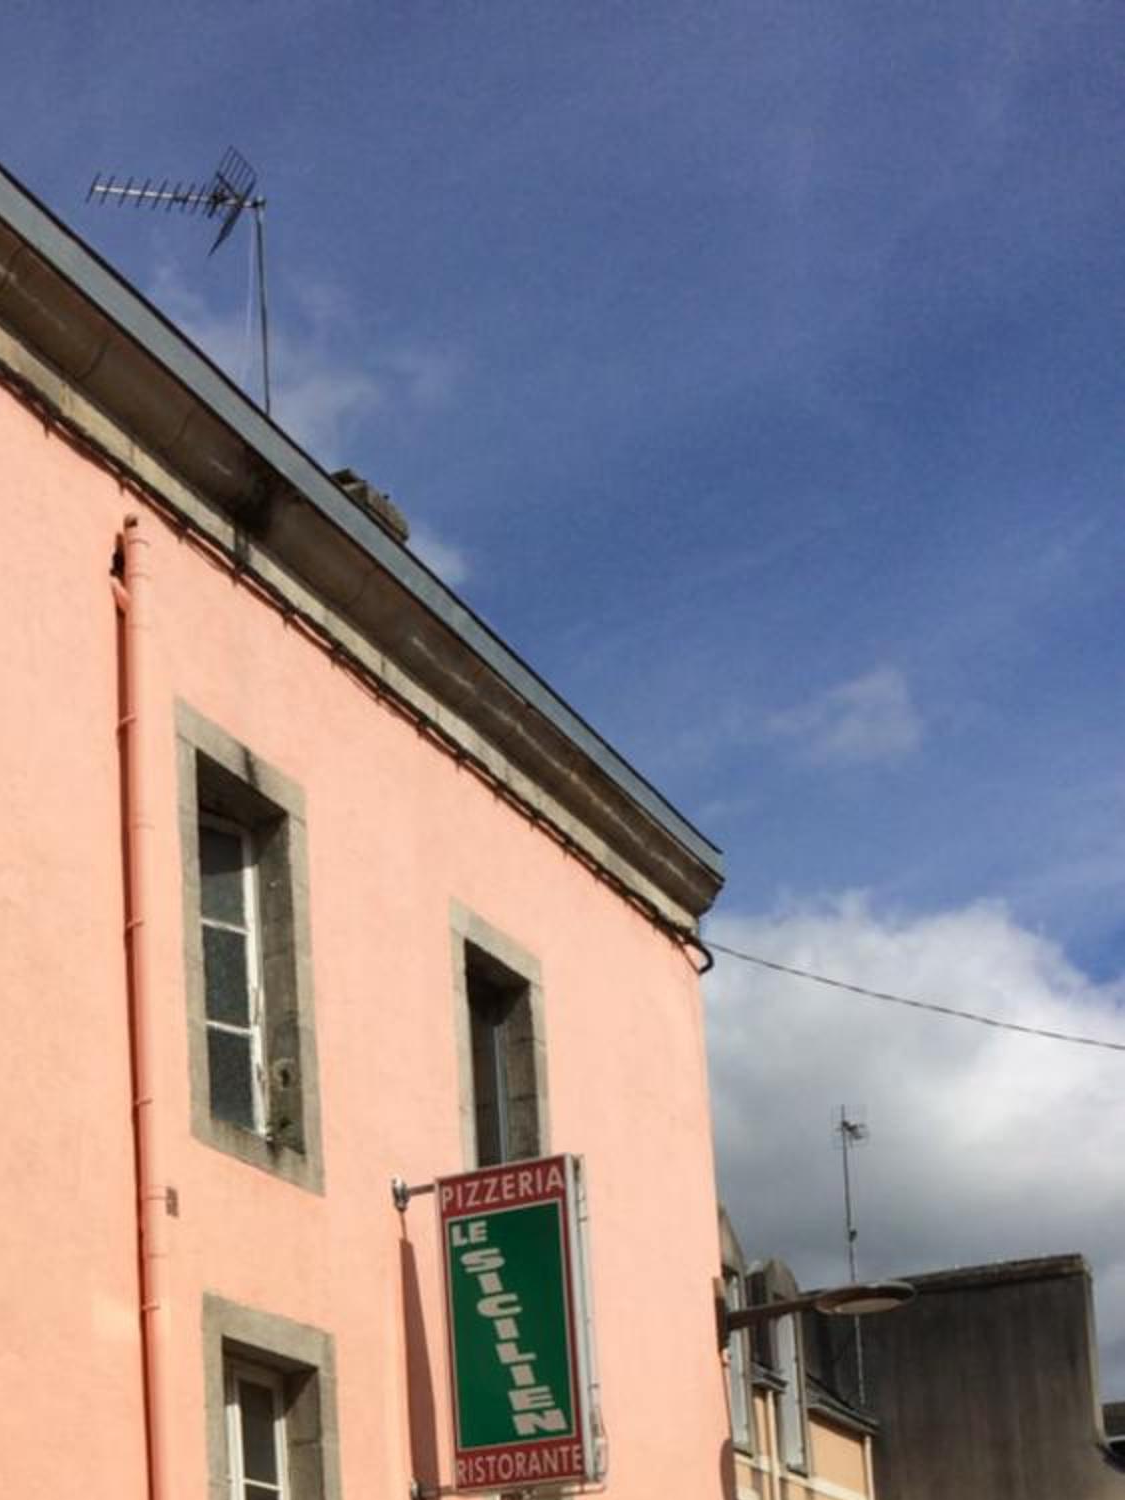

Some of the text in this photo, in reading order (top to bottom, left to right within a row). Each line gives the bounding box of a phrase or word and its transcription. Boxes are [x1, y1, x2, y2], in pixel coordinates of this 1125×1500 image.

[441, 1164, 564, 1213] PIZZERIA
[451, 1221, 488, 1247] LE
[460, 1248, 567, 1436] SICILIEN
[457, 1444, 582, 1485] RISTORANTE
